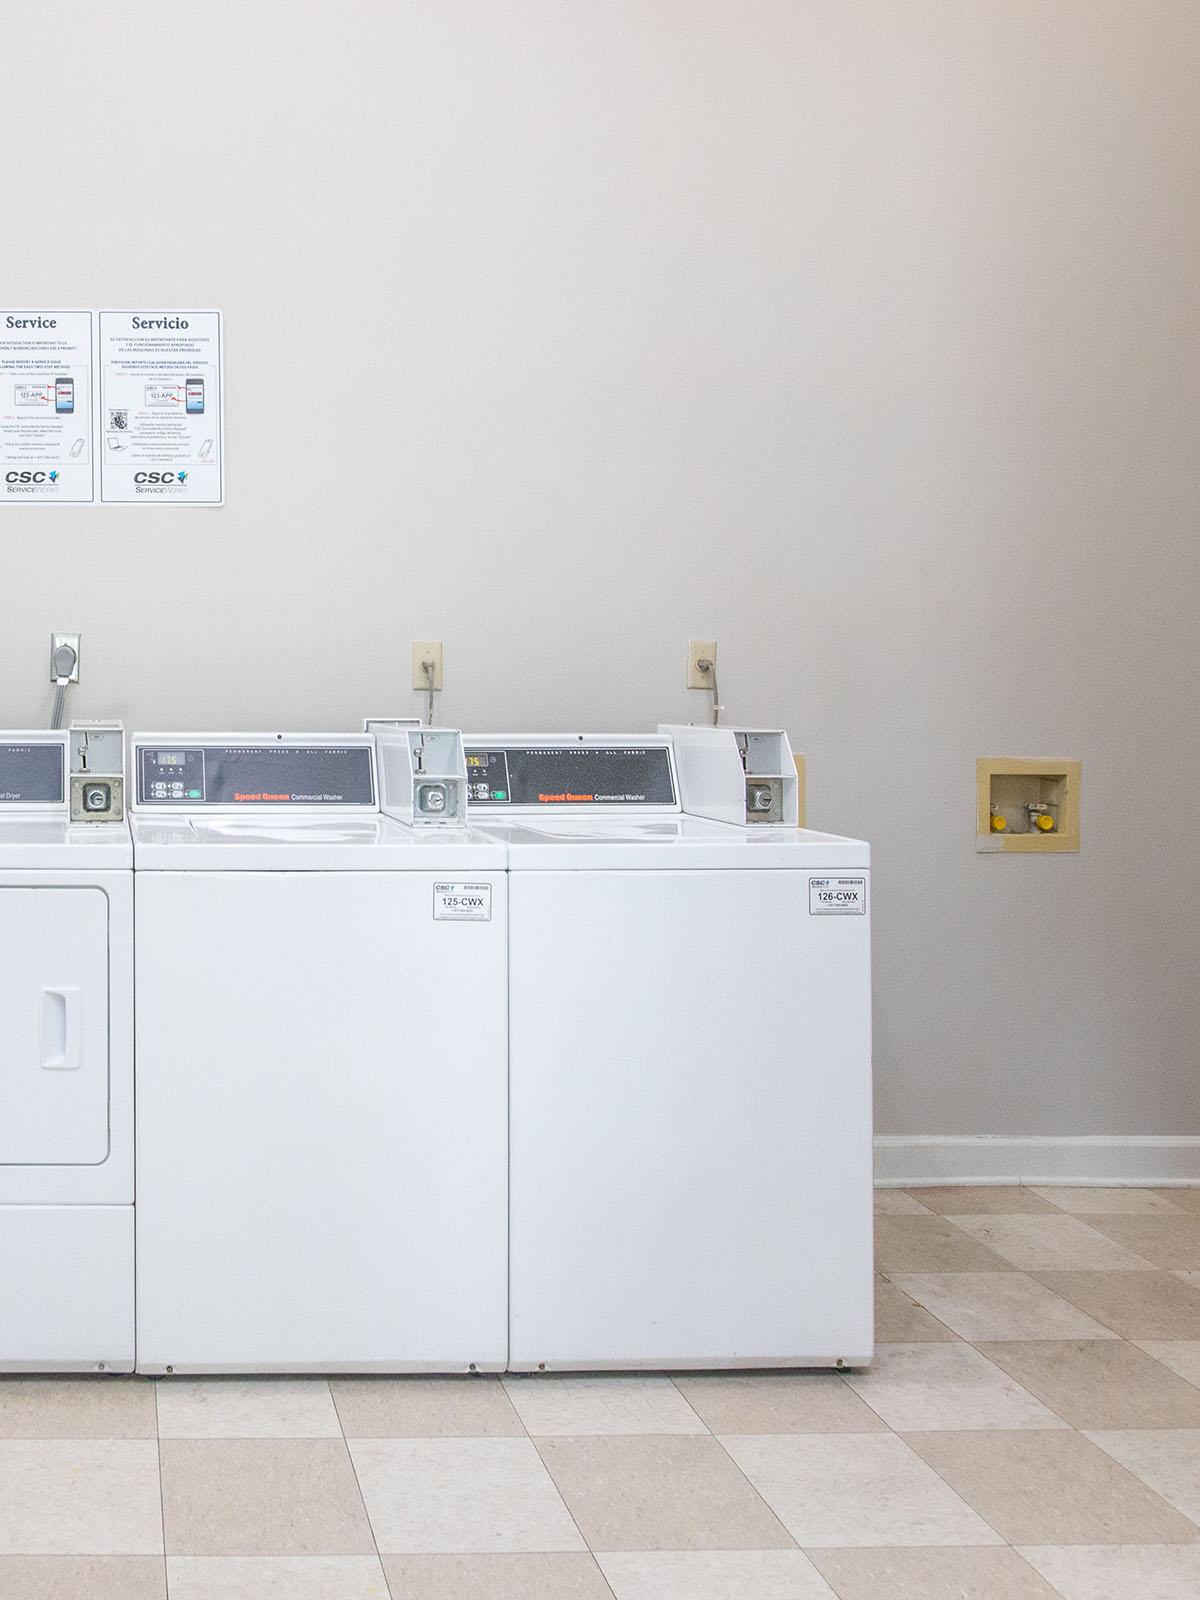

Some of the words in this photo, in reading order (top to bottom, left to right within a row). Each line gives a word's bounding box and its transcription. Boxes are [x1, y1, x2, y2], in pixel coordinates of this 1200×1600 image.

[6, 316, 57, 329] Service
[132, 316, 189, 330] Servicio
[5, 472, 46, 483] CSC
[134, 472, 174, 483] CSC
[234, 793, 261, 801] Speed
[539, 793, 565, 802] Speed
[818, 892, 858, 900] 126-CWX
[443, 898, 483, 906] 125-CWX
